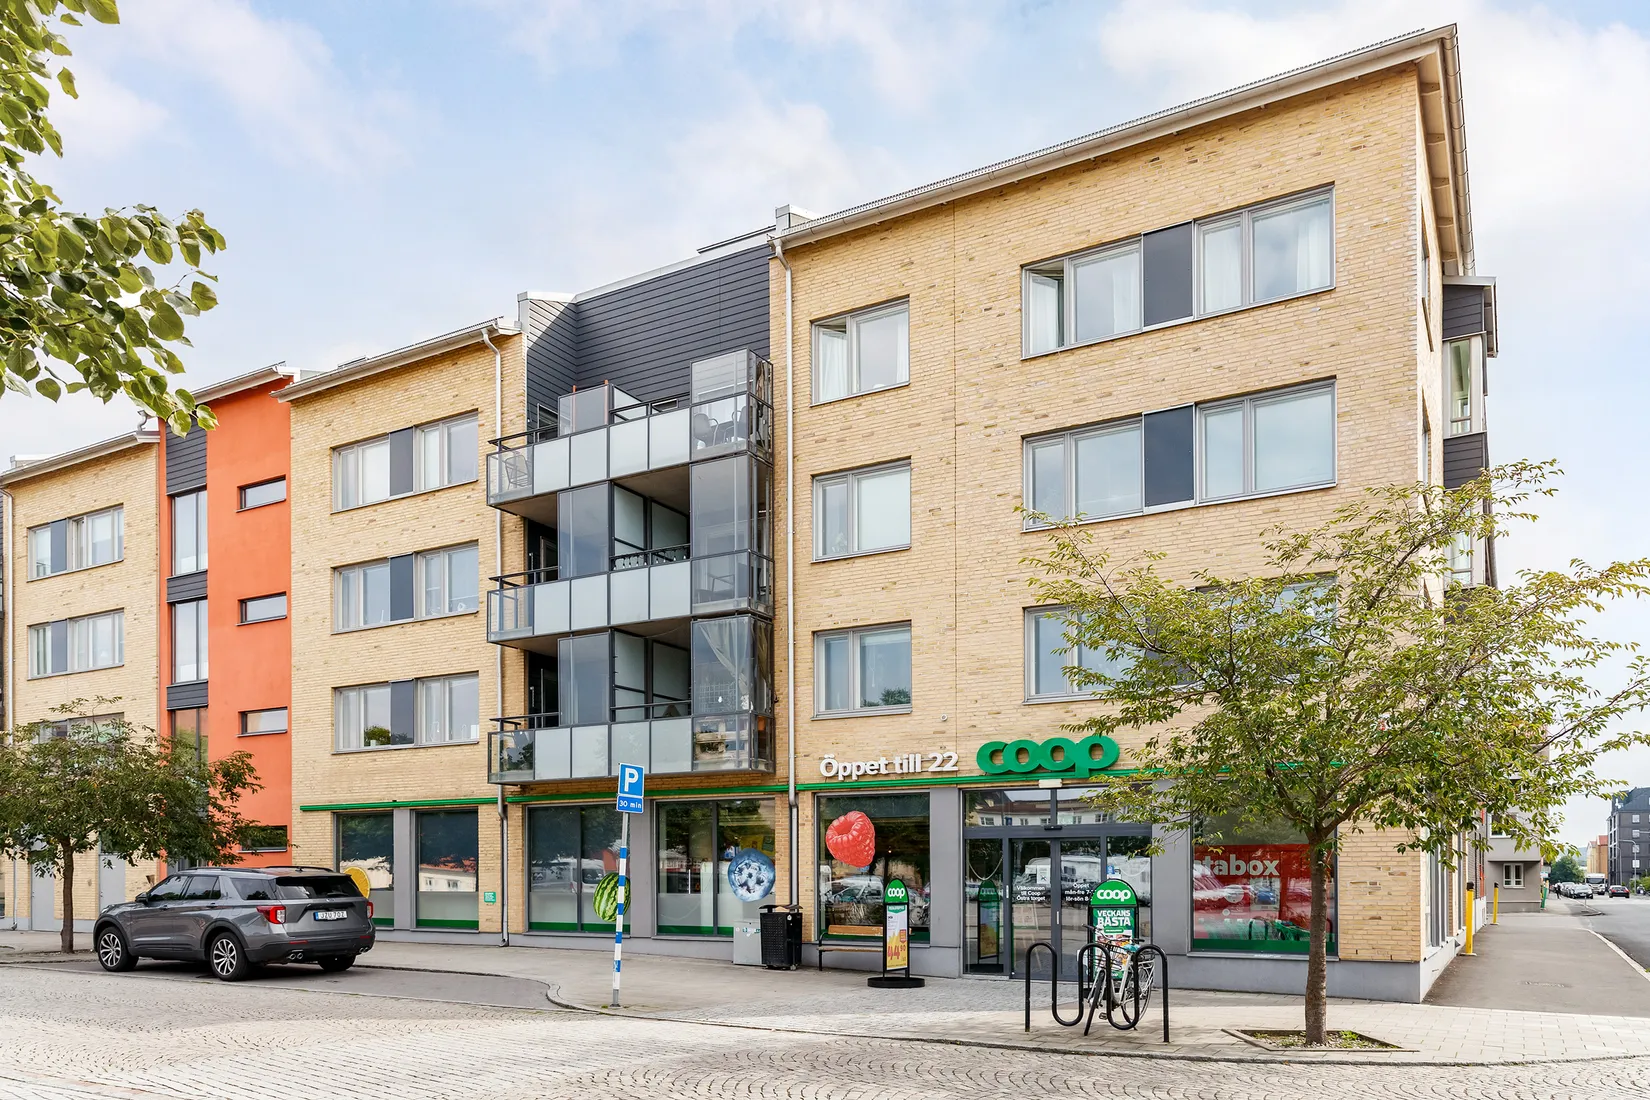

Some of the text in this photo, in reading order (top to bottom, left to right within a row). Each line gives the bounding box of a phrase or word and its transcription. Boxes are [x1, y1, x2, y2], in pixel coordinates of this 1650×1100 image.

[976, 735, 1120, 779] coop
[820, 751, 959, 781] Öppet till 22
[624, 767, 639, 792] P
[619, 799, 642, 809] 30 min
[887, 887, 906, 899] coop
[1096, 889, 1132, 902] coop
[1097, 909, 1131, 917] VECKANS
